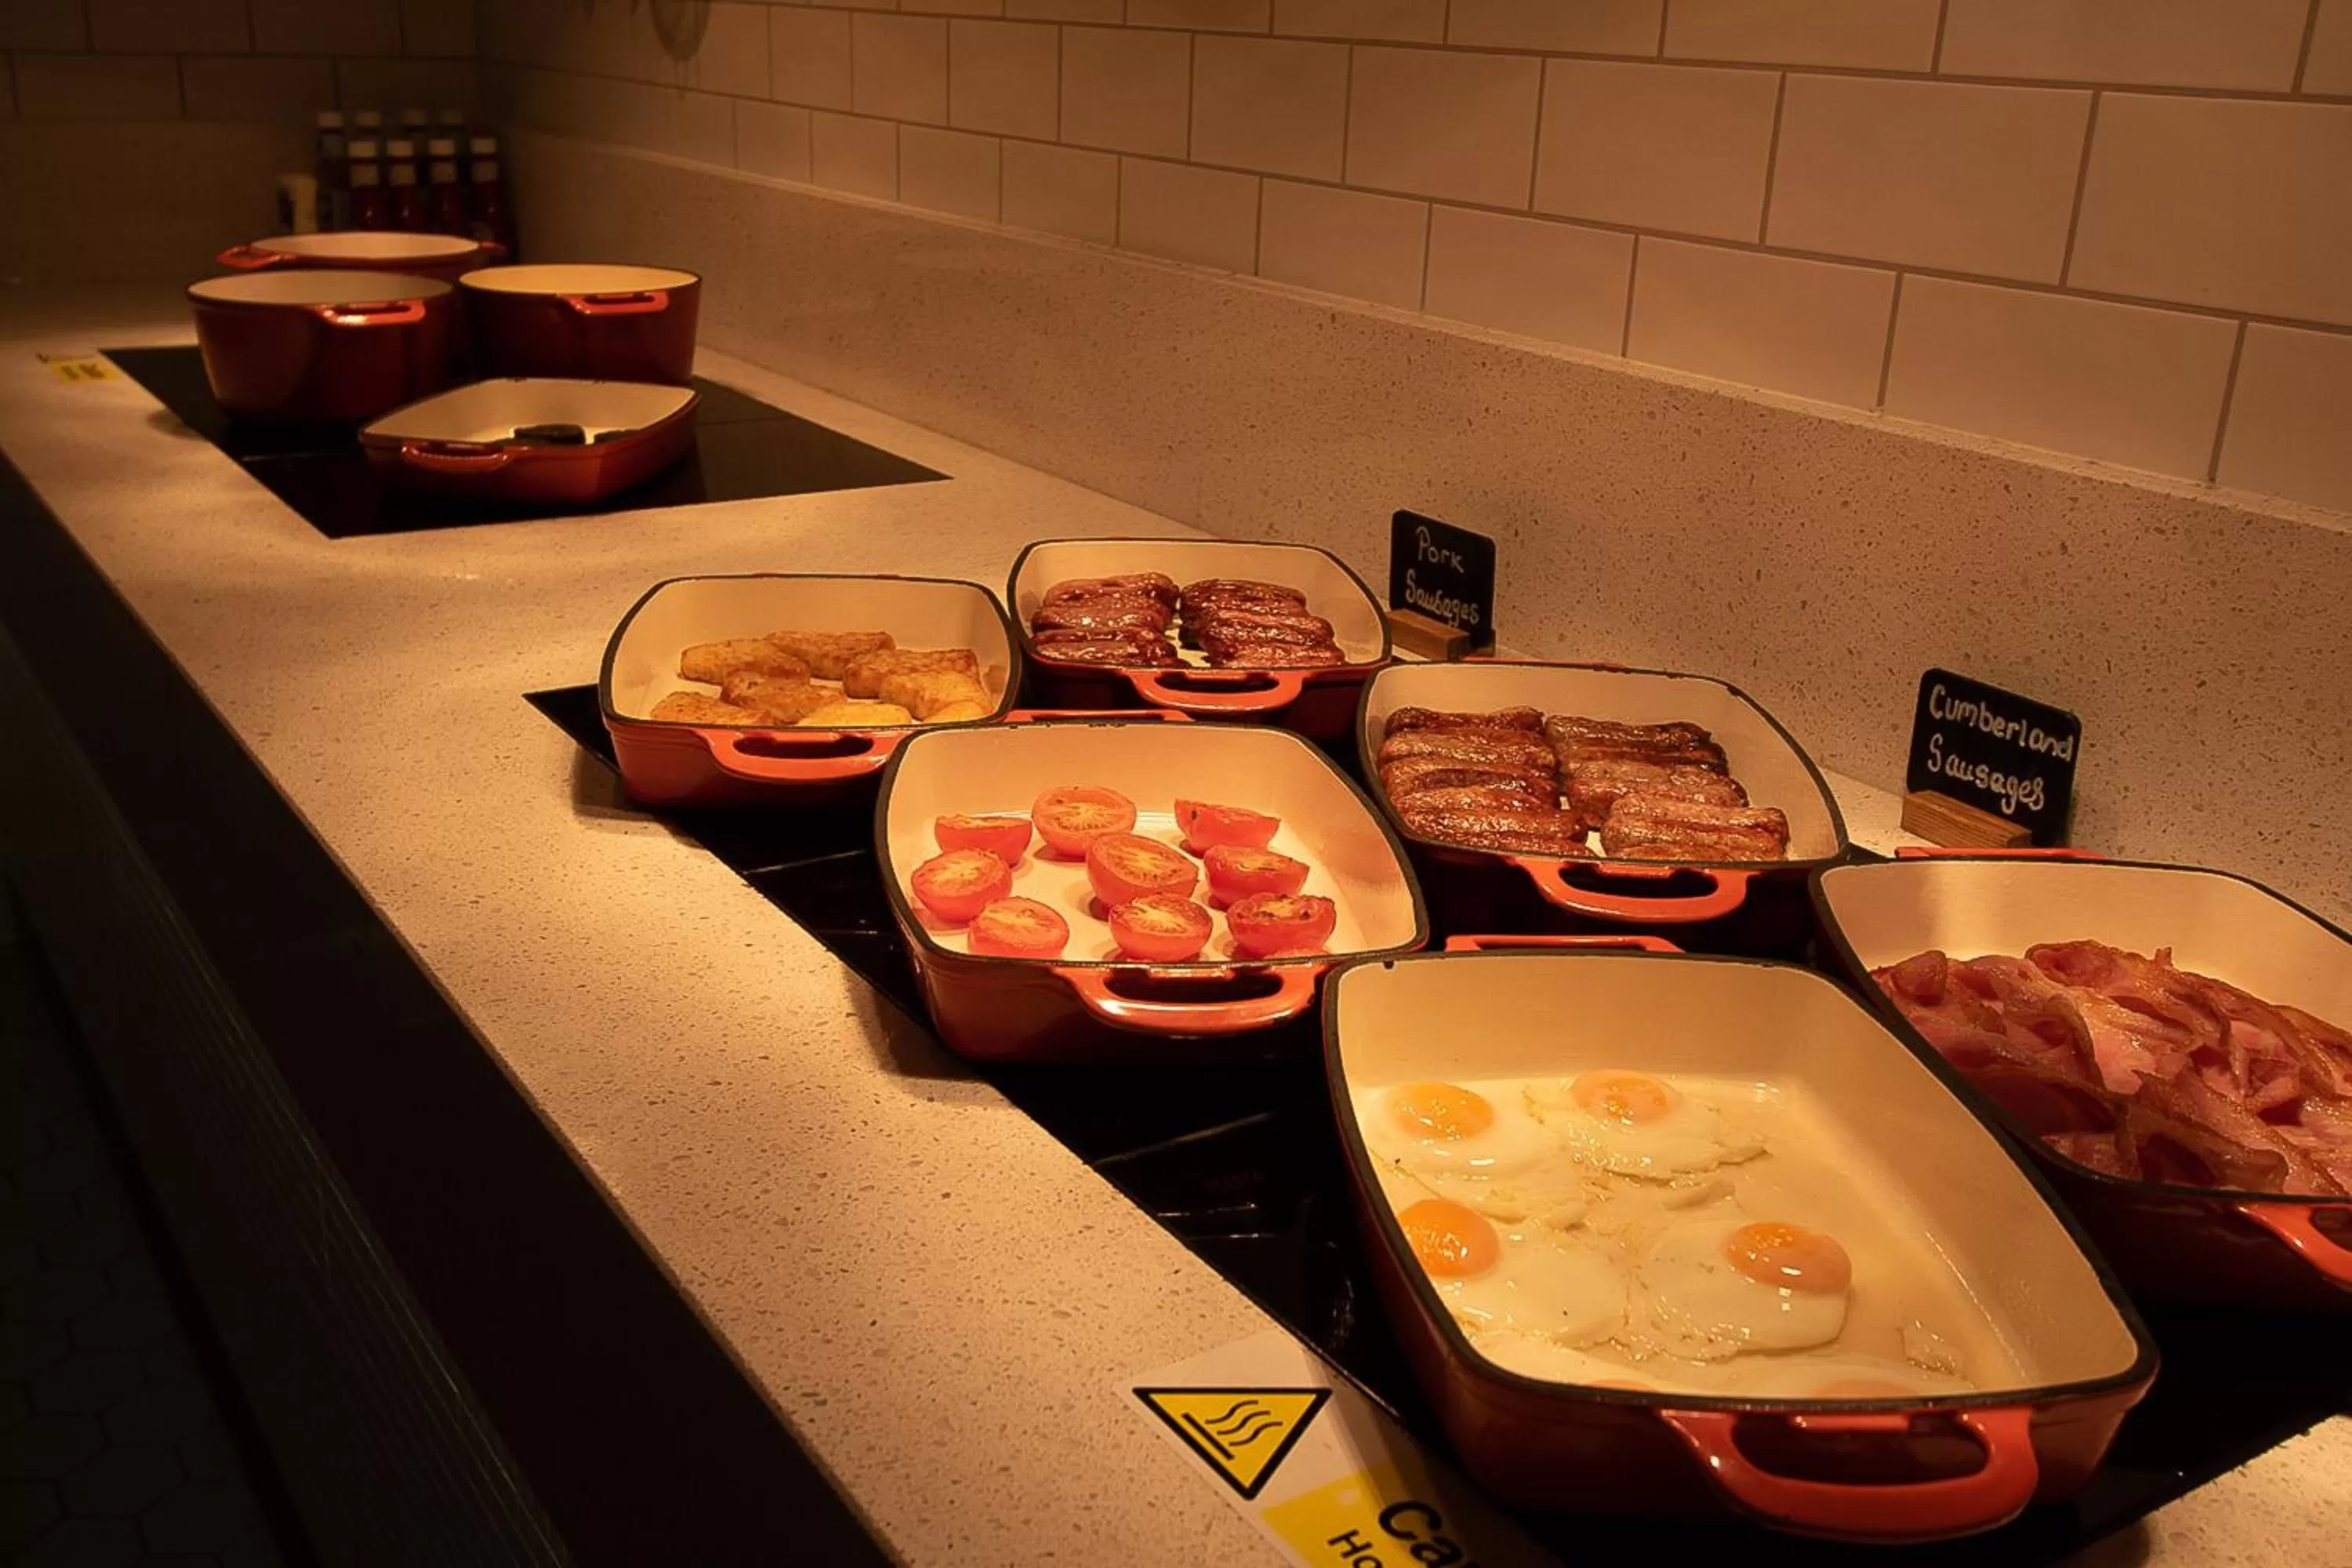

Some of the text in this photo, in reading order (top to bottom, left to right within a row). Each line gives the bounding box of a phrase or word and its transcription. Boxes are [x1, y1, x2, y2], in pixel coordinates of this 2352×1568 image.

[1415, 526, 1465, 573] Pork
[1929, 684, 2074, 761] Cumberland
[1927, 733, 2045, 815] Sausages
[1378, 1500, 1480, 1568] Ca
